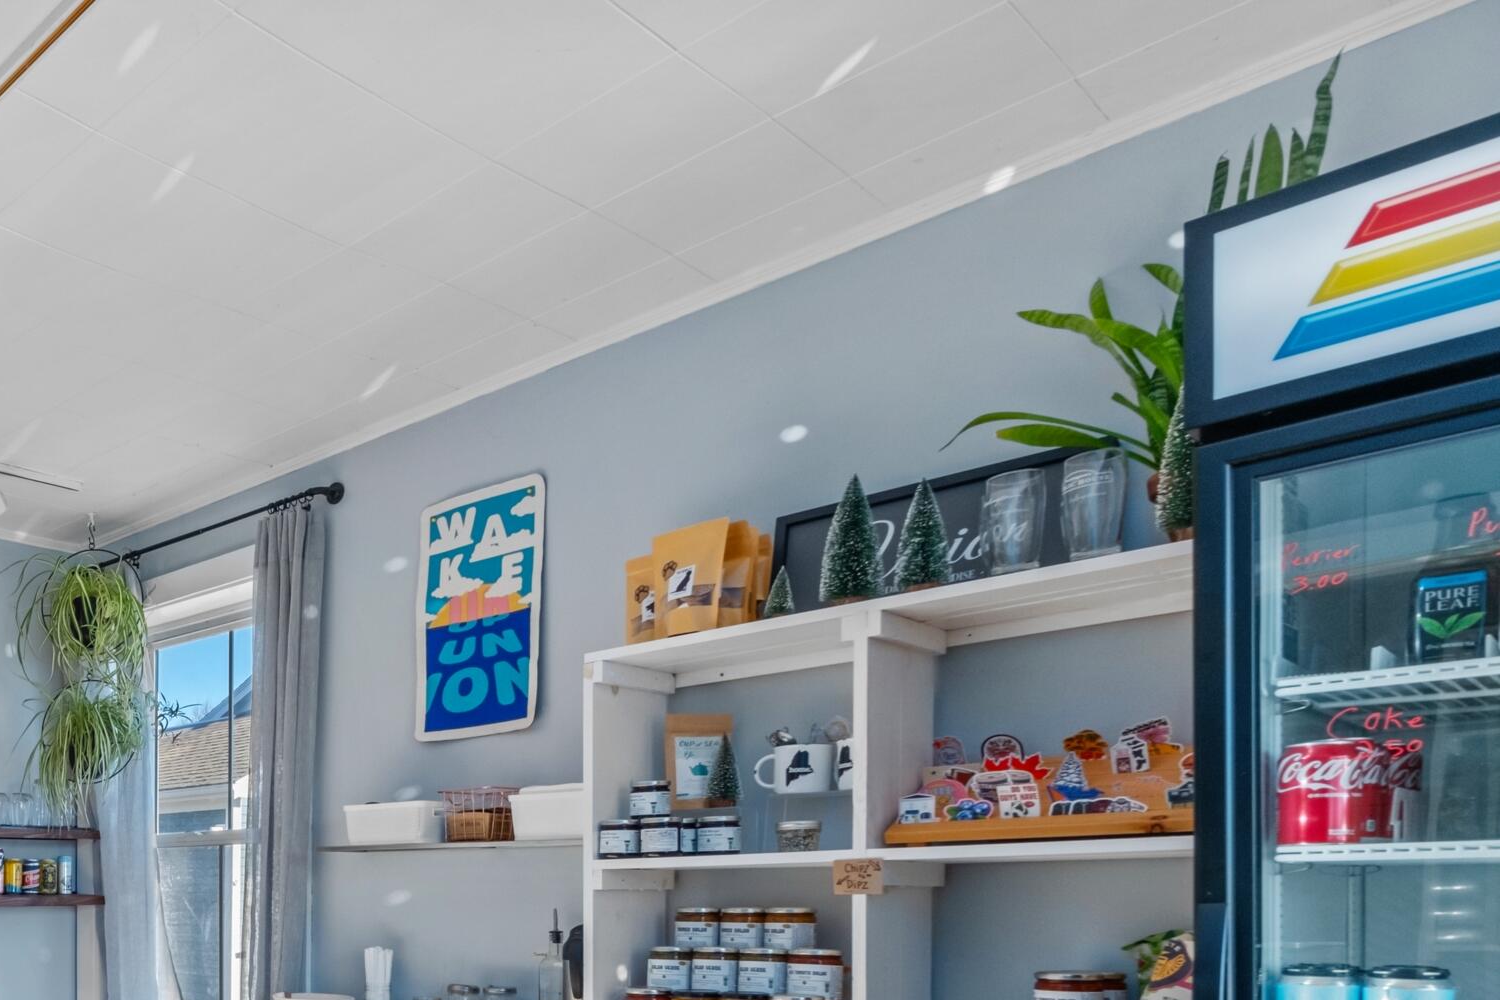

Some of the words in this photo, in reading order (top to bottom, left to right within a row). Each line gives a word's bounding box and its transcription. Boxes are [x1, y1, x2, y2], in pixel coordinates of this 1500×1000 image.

[1290, 571, 1348, 595] 3.00
[1424, 585, 1480, 601] PURE
[1424, 598, 1480, 613] LEAF
[1326, 706, 1426, 740] Coke
